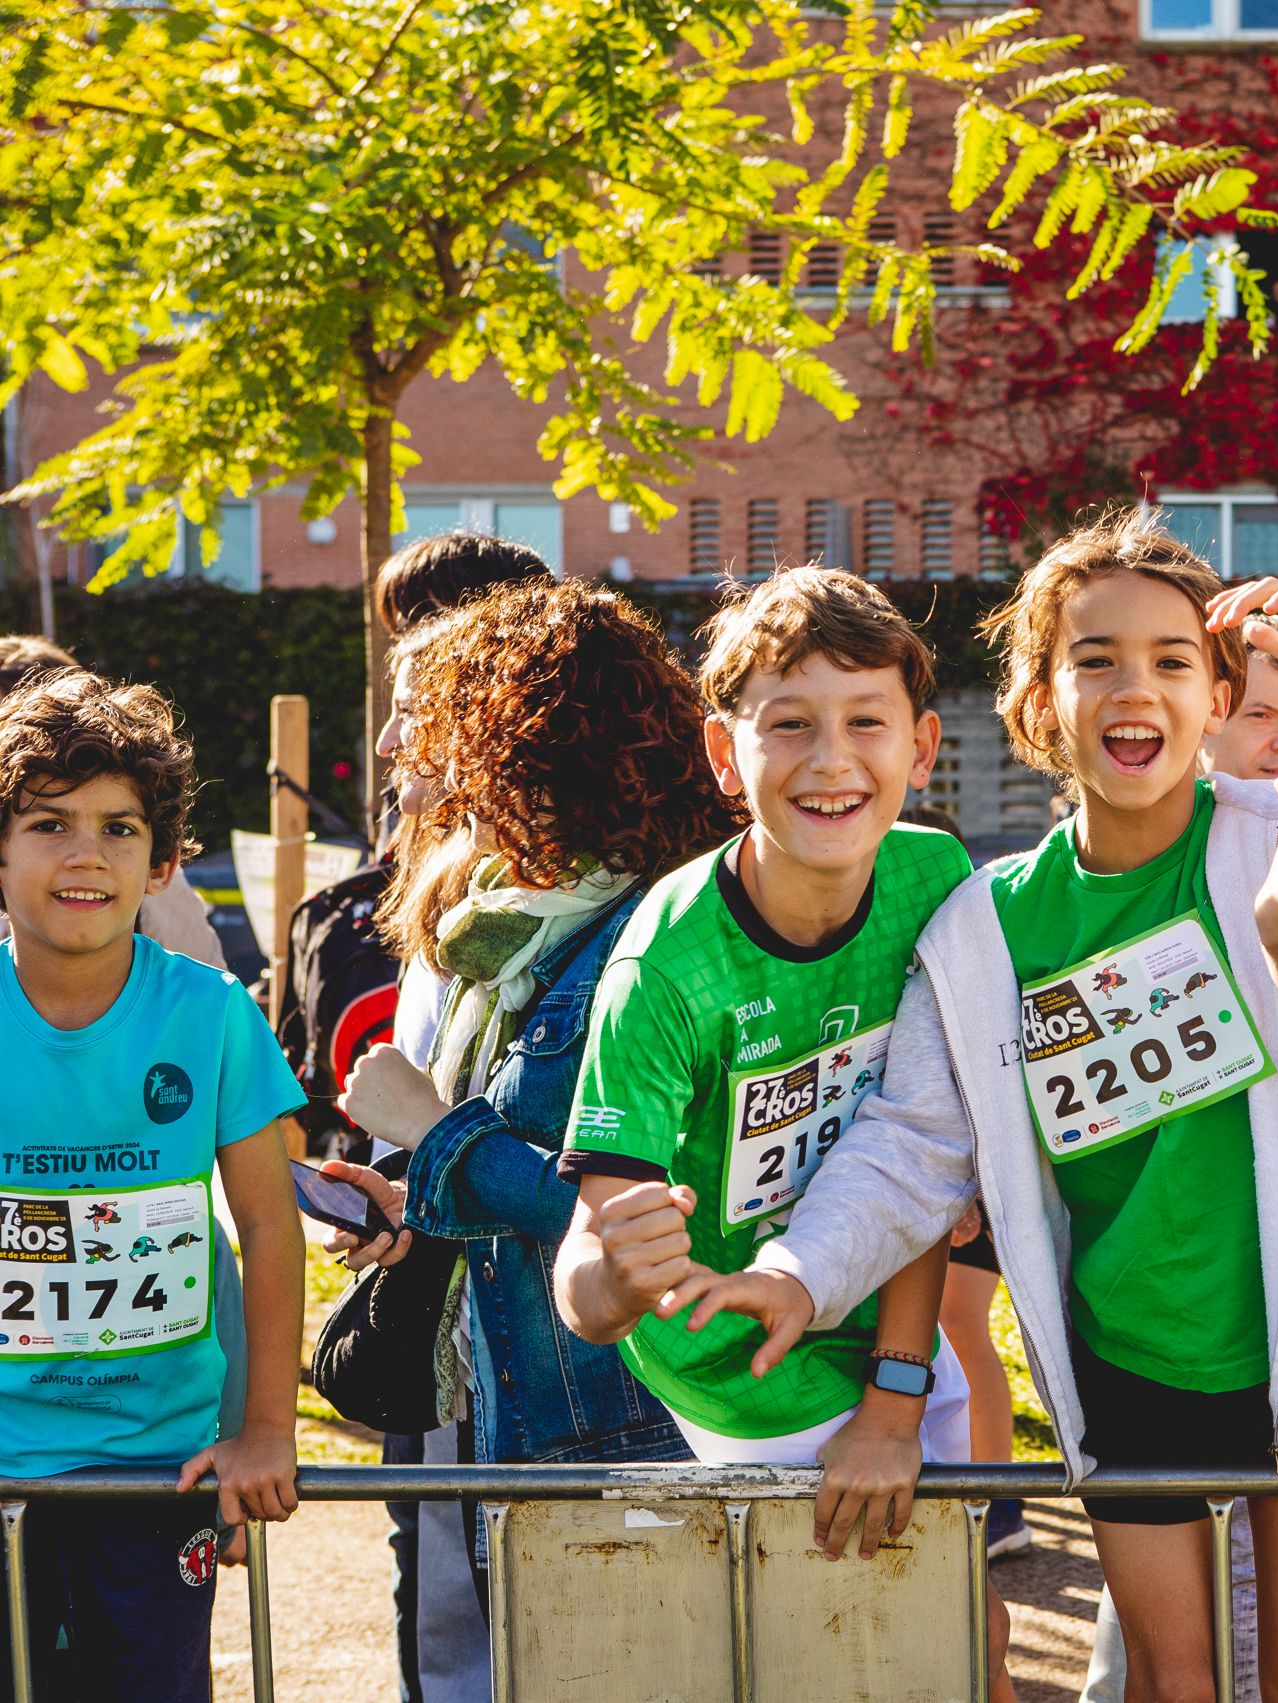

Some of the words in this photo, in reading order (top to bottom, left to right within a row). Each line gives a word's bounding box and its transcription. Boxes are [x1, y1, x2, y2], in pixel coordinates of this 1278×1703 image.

[735, 995, 777, 1026] ESCOLA
[1022, 1007, 1089, 1050] CROS
[736, 1033, 782, 1064] MIRADA
[1044, 1047, 1053, 1055] de
[1053, 1041, 1072, 1052] Sant
[1071, 1031, 1096, 1045] Cugat
[1046, 1014, 1217, 1119] 2205
[158, 1092, 188, 1104] andreu
[159, 1084, 178, 1096] sant
[1177, 1080, 1211, 1099] SantCugat
[747, 1082, 815, 1128] CROS
[746, 1125, 769, 1137] Ciutat
[770, 1122, 779, 1130] de
[779, 1115, 795, 1127] Sant
[795, 1106, 812, 1120] Cugat
[756, 1108, 858, 1187] 219
[2, 1152, 87, 1175] T'ESTIU
[95, 1149, 160, 1172] MOLT
[1, 1200, 22, 1226] 7è
[0, 1225, 67, 1251] ROS
[20, 1252, 40, 1260] Sant
[42, 1252, 67, 1261] Cugat
[1, 1273, 167, 1321] 2174
[30, 1374, 83, 1386] CAMPUS
[87, 1372, 141, 1386] OLÍMPIA
